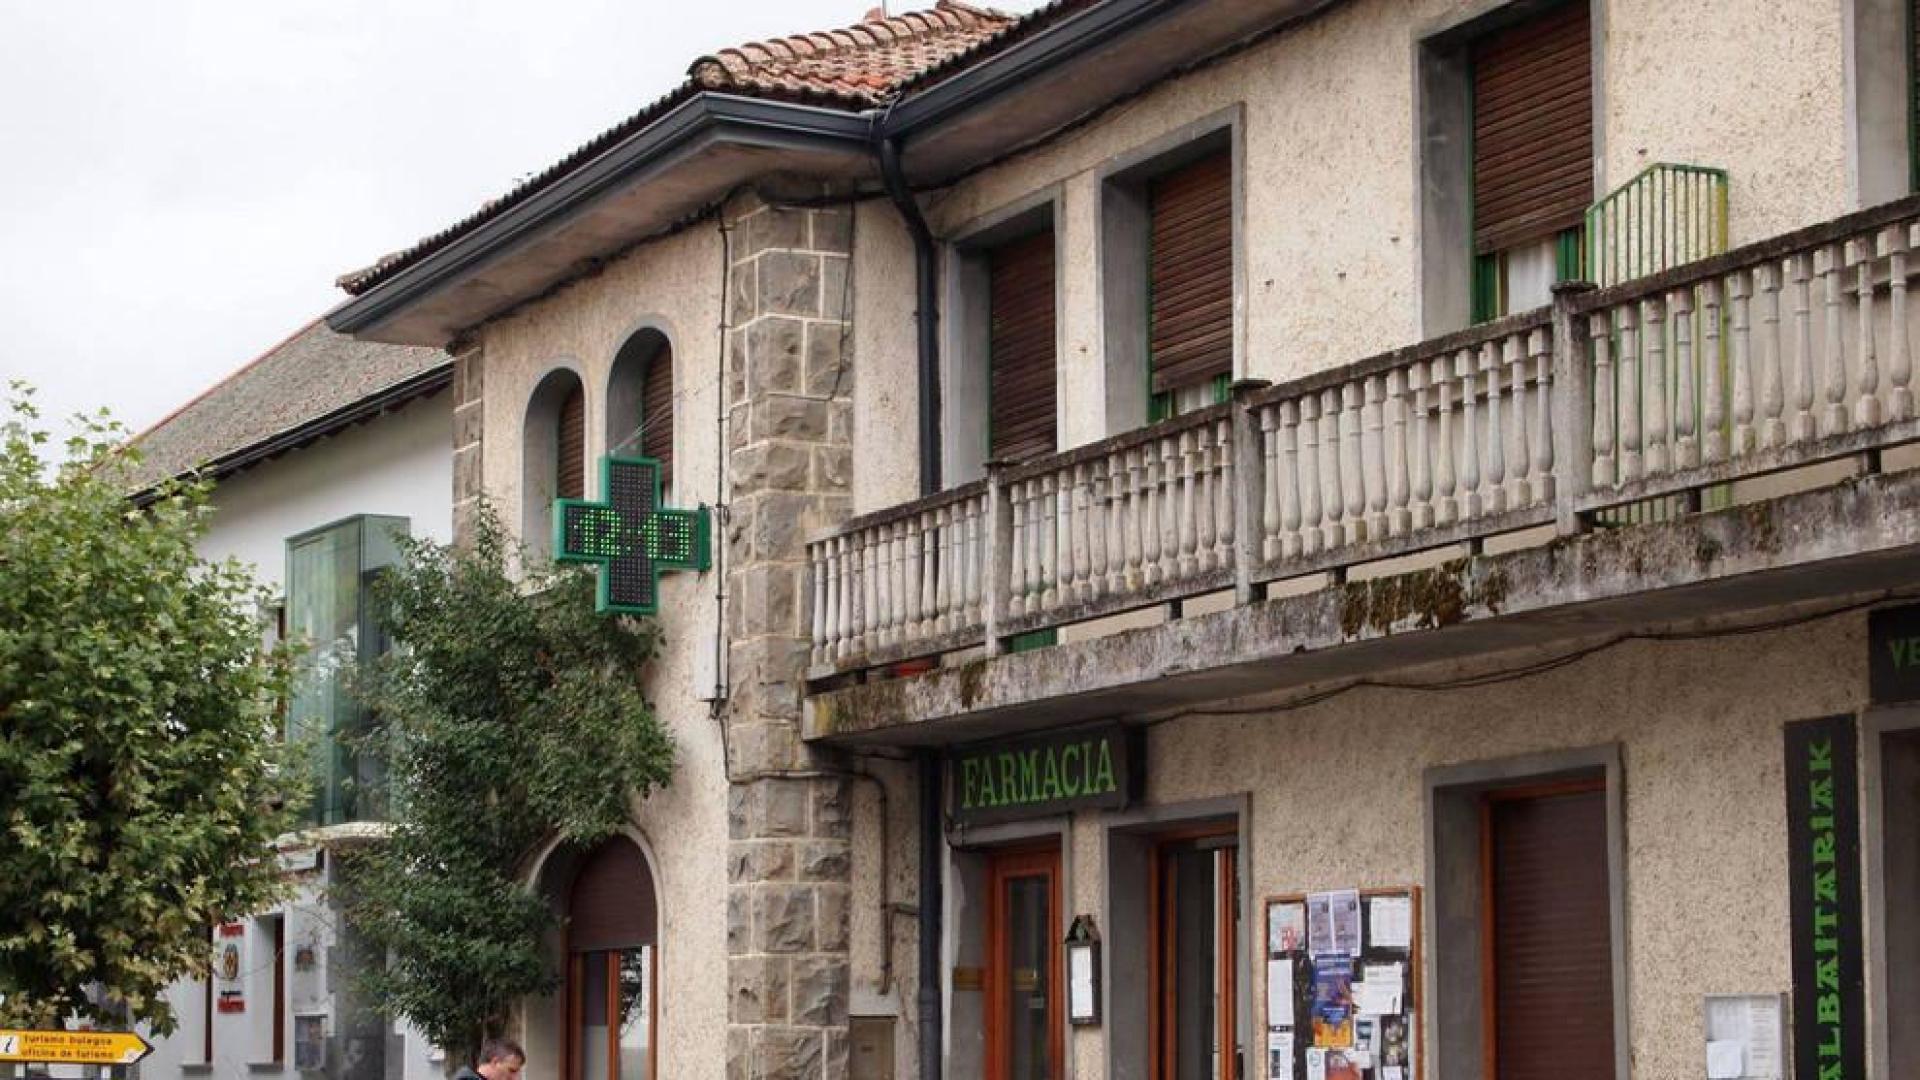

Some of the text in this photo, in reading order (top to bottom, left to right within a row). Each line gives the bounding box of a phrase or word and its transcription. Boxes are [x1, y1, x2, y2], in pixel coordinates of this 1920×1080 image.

[962, 739, 1117, 809] FARMACIA
[21, 1048, 114, 1060] oficina de turismo
